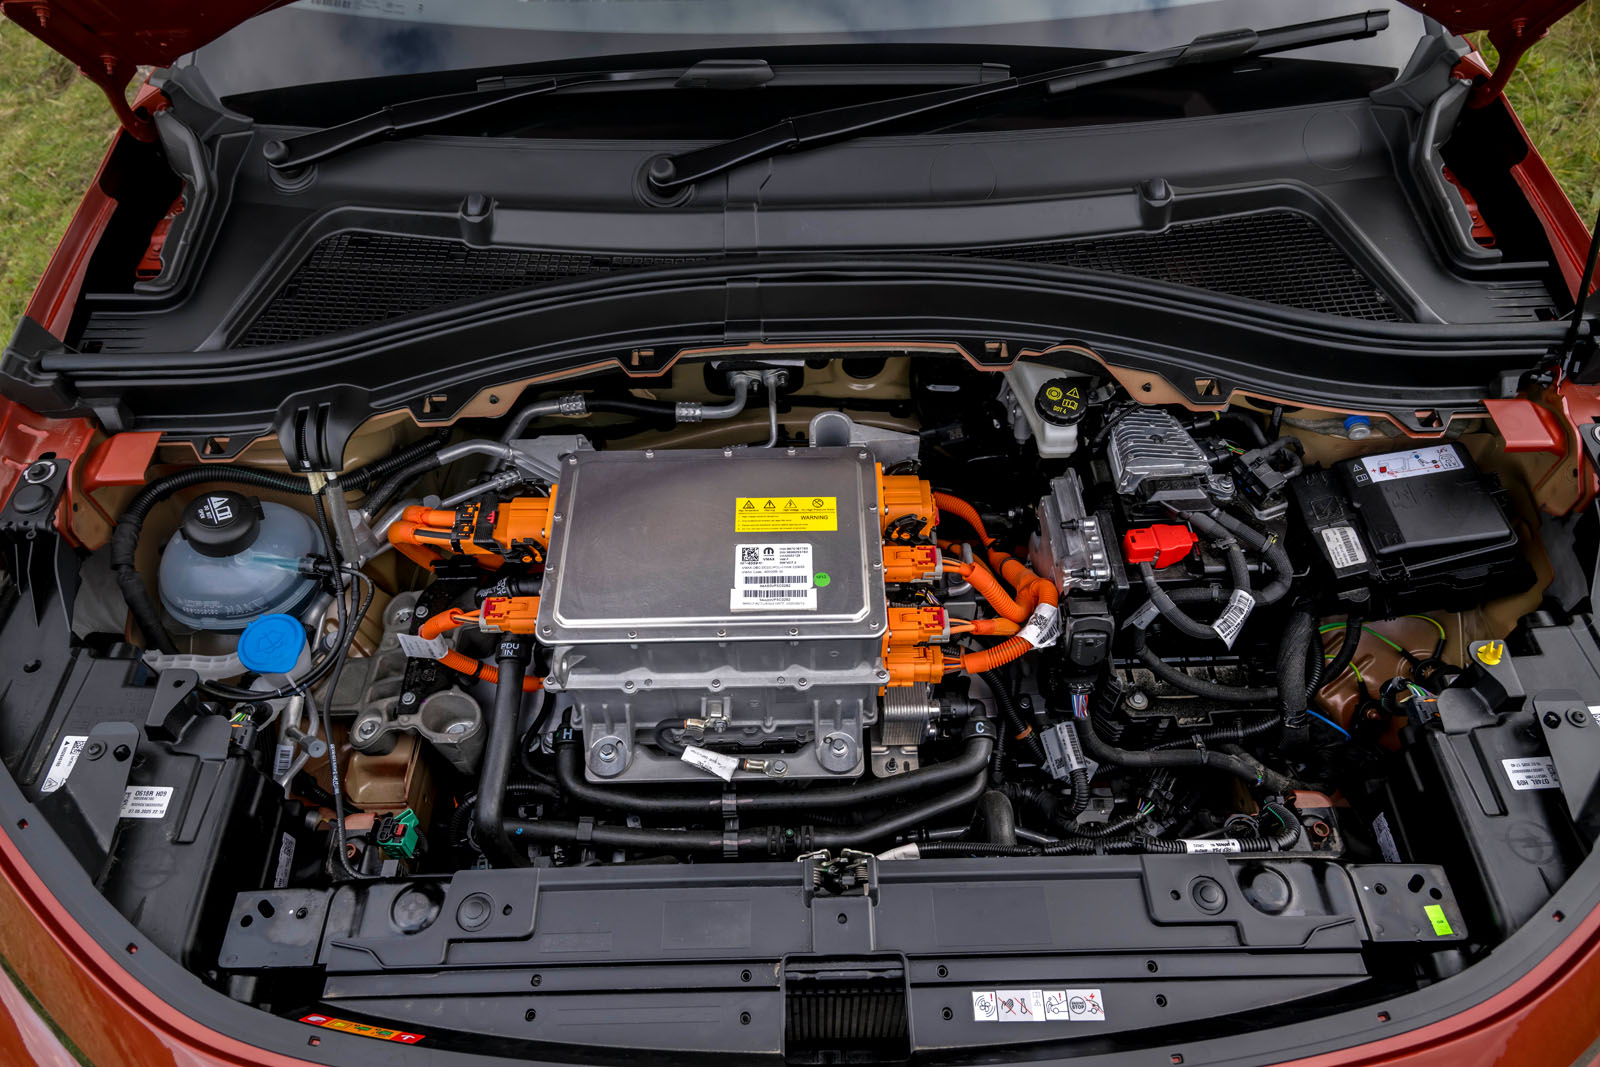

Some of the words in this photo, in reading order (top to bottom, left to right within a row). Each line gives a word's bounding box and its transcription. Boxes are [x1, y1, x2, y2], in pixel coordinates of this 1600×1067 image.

[198, 508, 206, 519] OPEN
[205, 511, 213, 519] NOT
[976, 721, 985, 733] C
[562, 728, 573, 739] H
